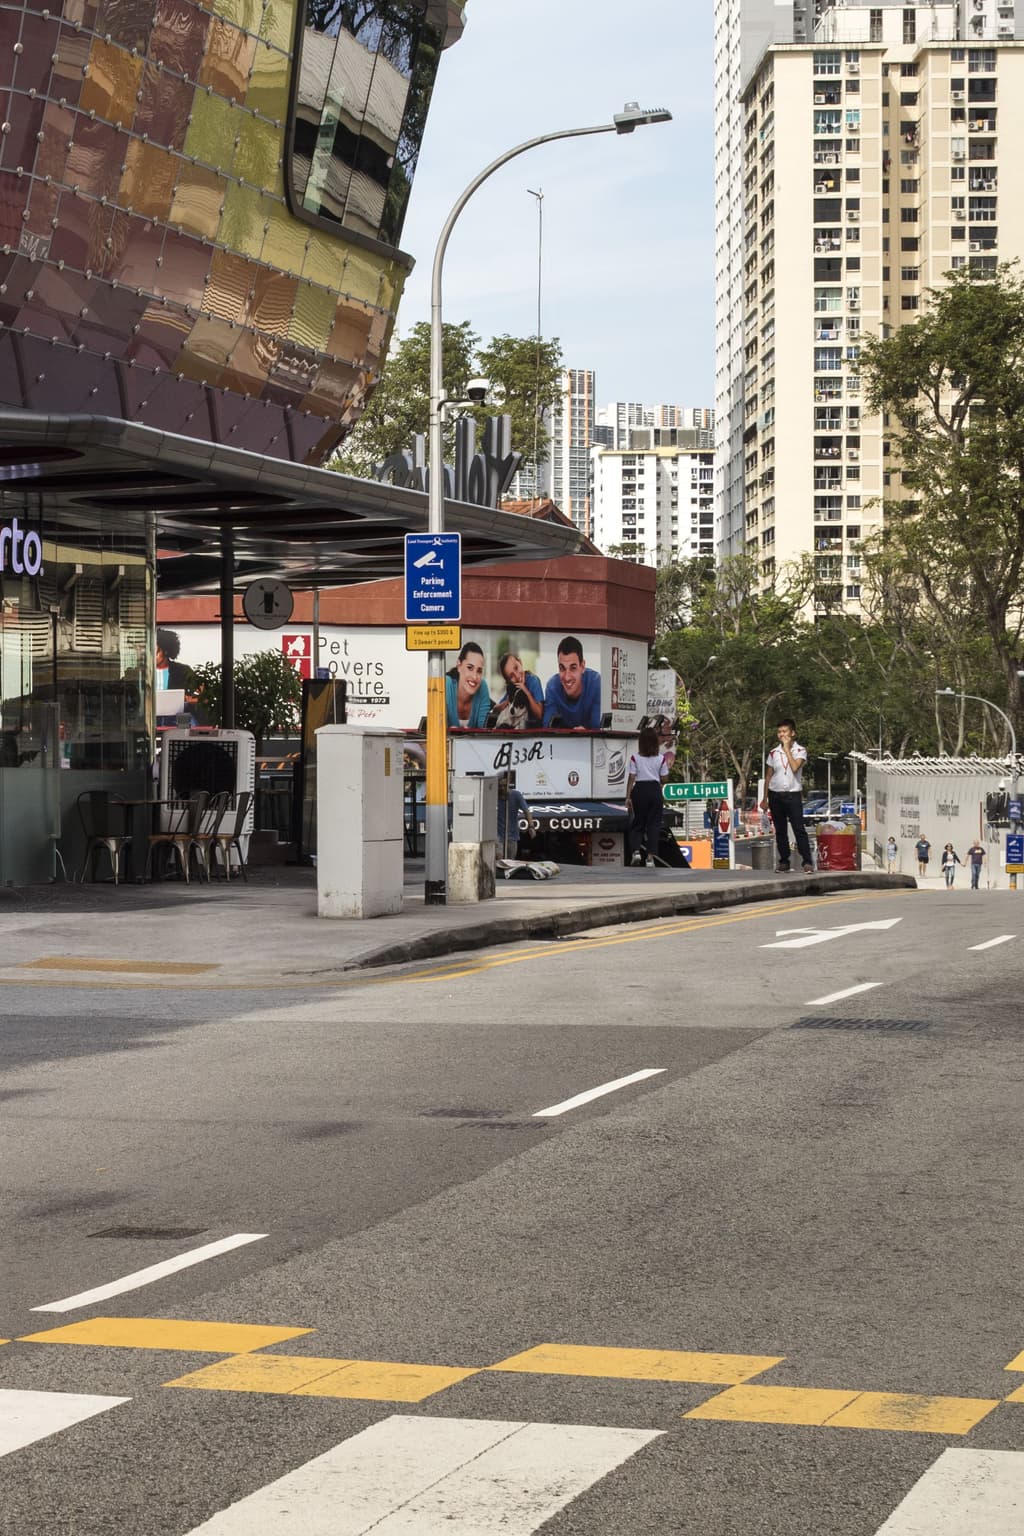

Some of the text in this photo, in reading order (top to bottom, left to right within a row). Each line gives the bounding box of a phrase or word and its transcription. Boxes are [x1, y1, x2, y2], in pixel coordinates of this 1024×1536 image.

[421, 577, 445, 586] Parking
[413, 590, 452, 598] Enforcement
[421, 604, 445, 612] Camera
[317, 637, 349, 656] Pet
[328, 661, 384, 676] overs
[670, 785, 725, 797] Lor Liput
[549, 817, 603, 830] COURT
